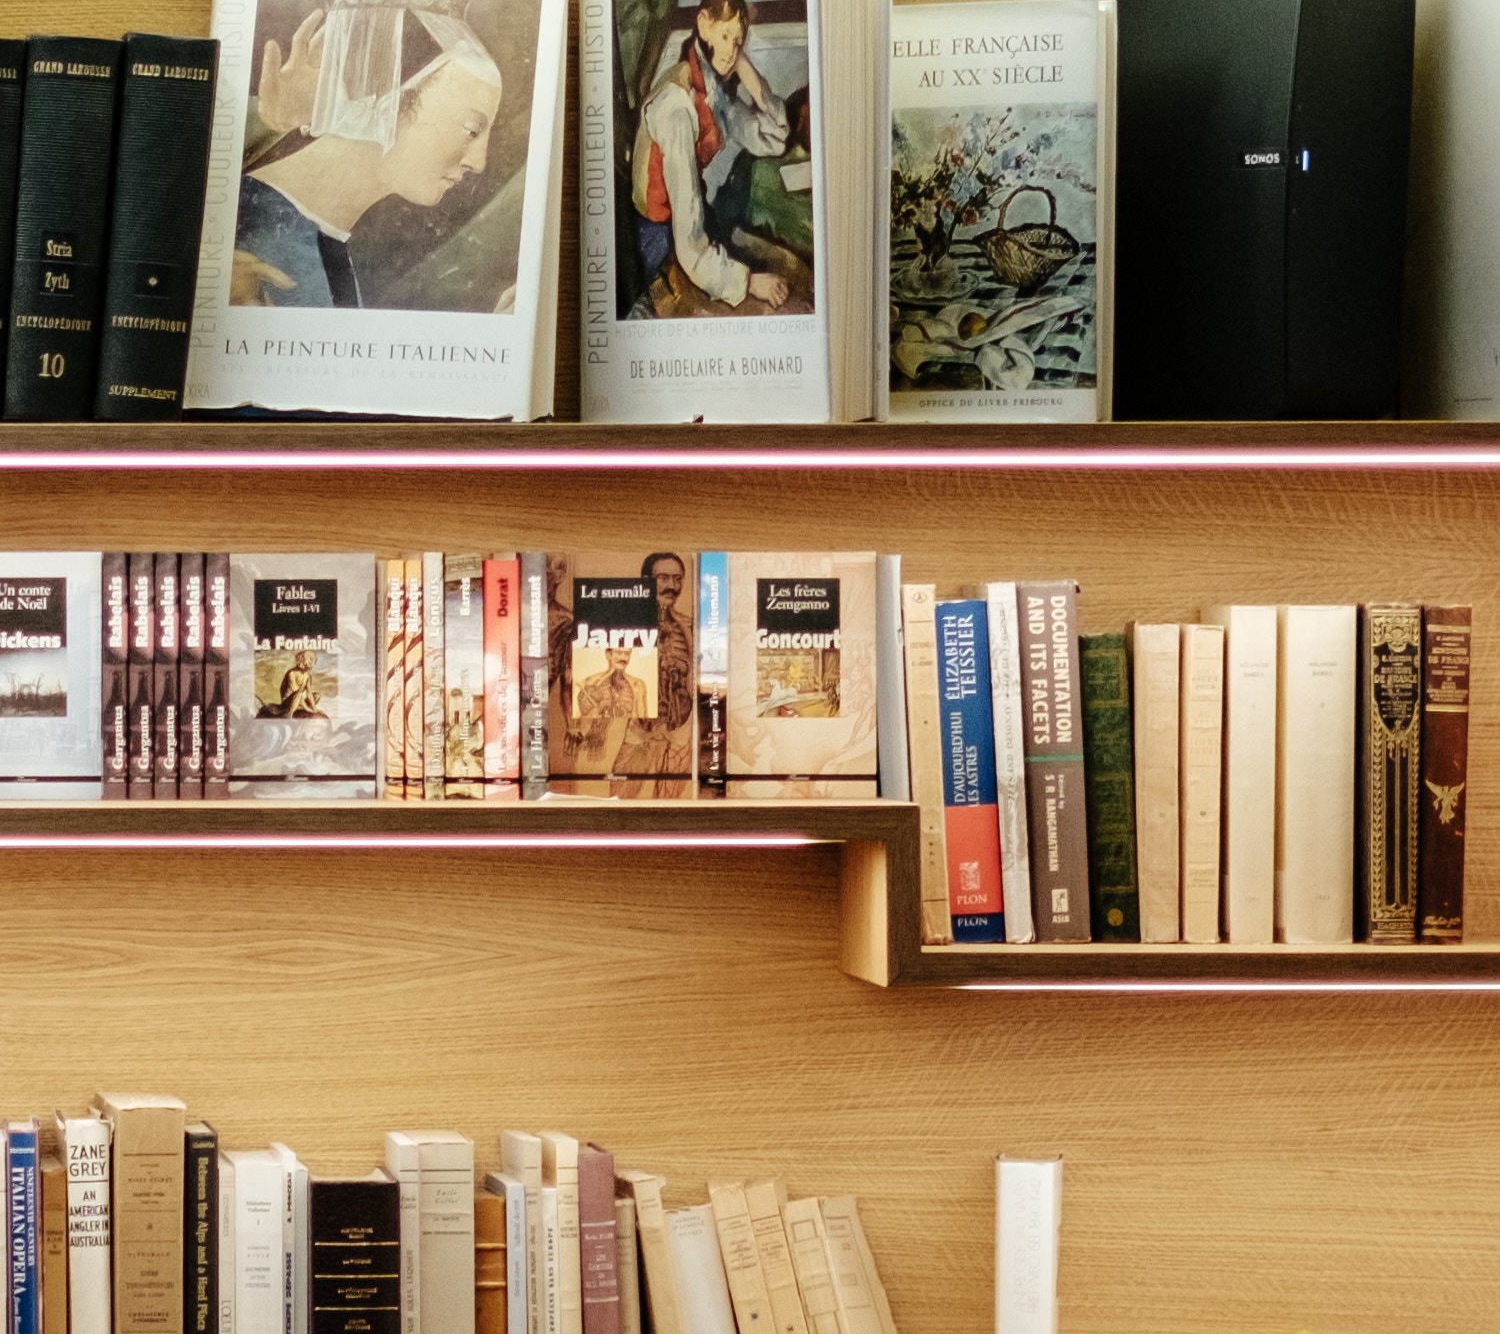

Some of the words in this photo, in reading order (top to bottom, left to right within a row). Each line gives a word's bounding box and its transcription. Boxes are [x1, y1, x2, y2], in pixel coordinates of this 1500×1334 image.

[952, 33, 1064, 58] FRANÇAISE
[919, 71, 943, 88] AU
[992, 64, 1064, 85] SIÈCLE
[586, 105, 607, 216] COULEUR
[1244, 153, 1280, 166] SONOS
[587, 247, 610, 364] PEINTURE
[225, 339, 249, 355] LA
[263, 340, 378, 359] PEINTURE
[389, 344, 511, 365] ITALIENNE
[39, 353, 65, 377] 10
[630, 361, 644, 378] DE
[649, 359, 724, 378] BAUDELAIRE
[727, 359, 736, 375] A
[742, 356, 803, 376] BONNARD
[19, 585, 51, 596] conte
[276, 587, 316, 600] Fables
[497, 578, 508, 617] Dorat
[581, 585, 597, 599] Le
[602, 585, 650, 599] surmâle
[770, 585, 791, 597] Les
[796, 586, 826, 598] frères
[0, 599, 15, 610] de
[18, 598, 47, 610] Noël
[161, 577, 175, 647] Rabelais
[272, 603, 300, 613] Livres
[1027, 597, 1044, 635] AND
[255, 638, 272, 650] La
[275, 635, 339, 651] Fontaine
[573, 624, 658, 651] Jarry
[757, 629, 841, 648] Goncourt
[942, 616, 958, 702] ÉLIZABETH
[958, 615, 976, 699] TEISSIER
[1030, 643, 1046, 670] ITS
[1050, 596, 1072, 743] DOCUMENTATION
[1030, 679, 1051, 744] FACETS
[163, 706, 175, 769] Gargantua
[957, 894, 987, 905] PLON
[70, 1145, 106, 1160] ZANE
[69, 1162, 106, 1177] GREY
[12, 1167, 25, 1235] ITALIAN
[83, 1190, 96, 1201] AN
[69, 1204, 108, 1217] AMERICAN
[69, 1220, 98, 1232] ANGLER
[69, 1236, 110, 1247] AUSTRALIA
[12, 1238, 27, 1295] OPERA
